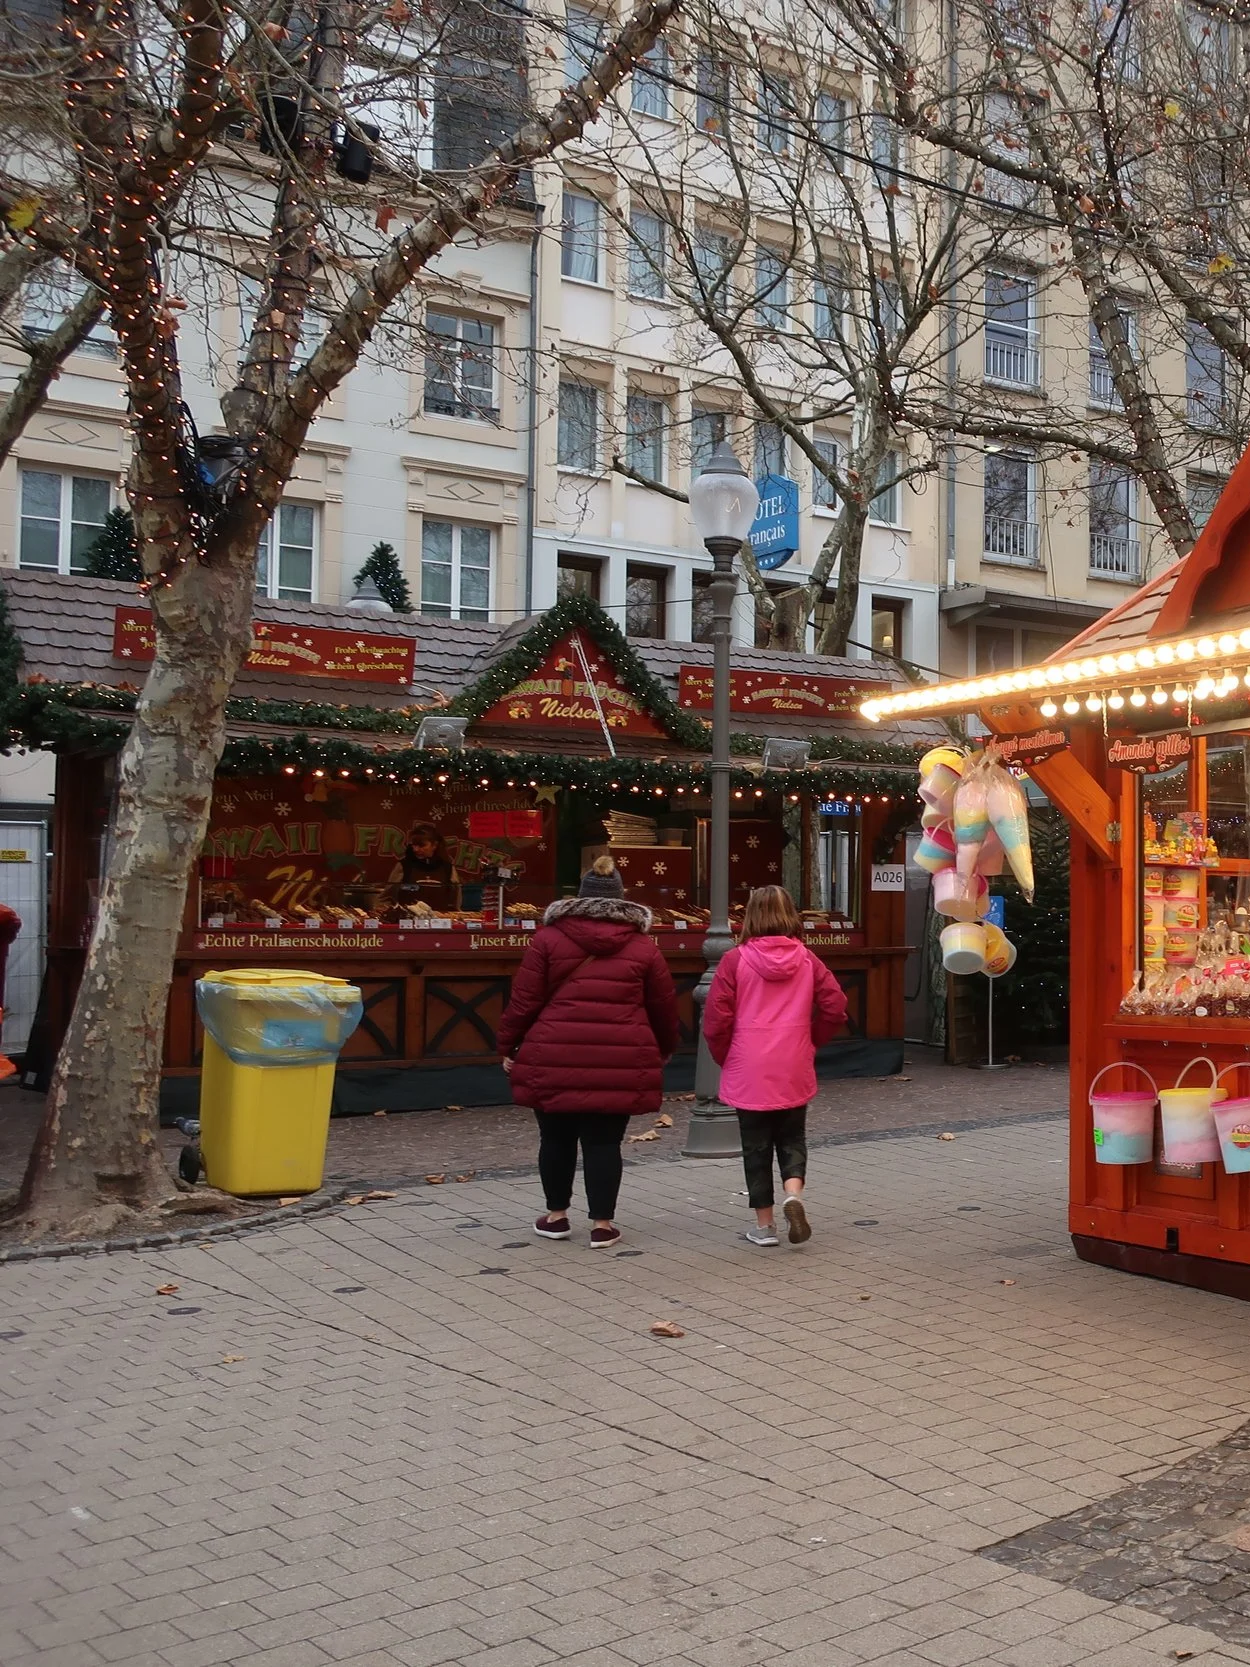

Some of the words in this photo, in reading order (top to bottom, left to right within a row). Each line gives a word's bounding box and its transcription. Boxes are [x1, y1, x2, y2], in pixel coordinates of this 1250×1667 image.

[755, 495, 786, 520] ÔTEL
[750, 520, 786, 547] rançais
[121, 623, 148, 633] Merry
[334, 646, 358, 655] Frohe
[248, 651, 291, 667] Nielsen
[539, 697, 604, 720] Nielsen
[771, 697, 804, 710] Nielsen
[1108, 738, 1155, 763] Amandes
[202, 822, 322, 860] WAII
[873, 871, 903, 883] A026
[204, 933, 245, 948] Echte
[249, 933, 384, 948] Pralinenschokolade
[470, 934, 505, 948] Unser
